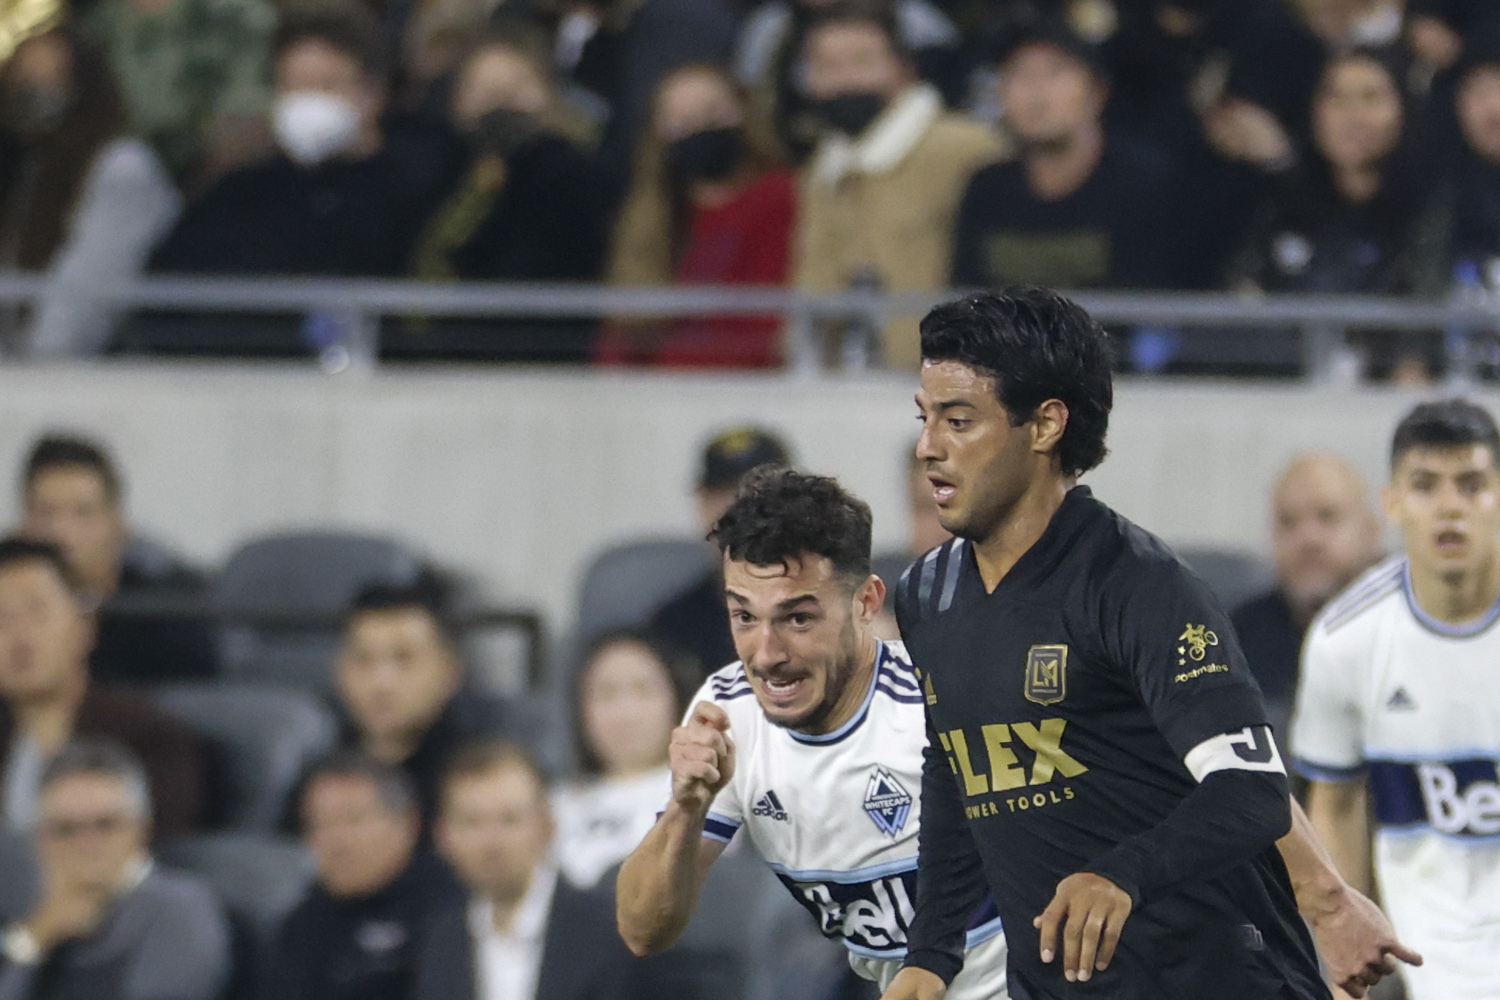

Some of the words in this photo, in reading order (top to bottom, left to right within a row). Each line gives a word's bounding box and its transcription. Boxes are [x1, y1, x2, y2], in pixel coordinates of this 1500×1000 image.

[864, 796, 911, 811] WHITECAPS
[882, 807, 894, 816] FC
[965, 801, 999, 820] OWER
[1006, 786, 1075, 813] TOOLS
[752, 804, 790, 822] adidas
[800, 876, 916, 947] Bell
